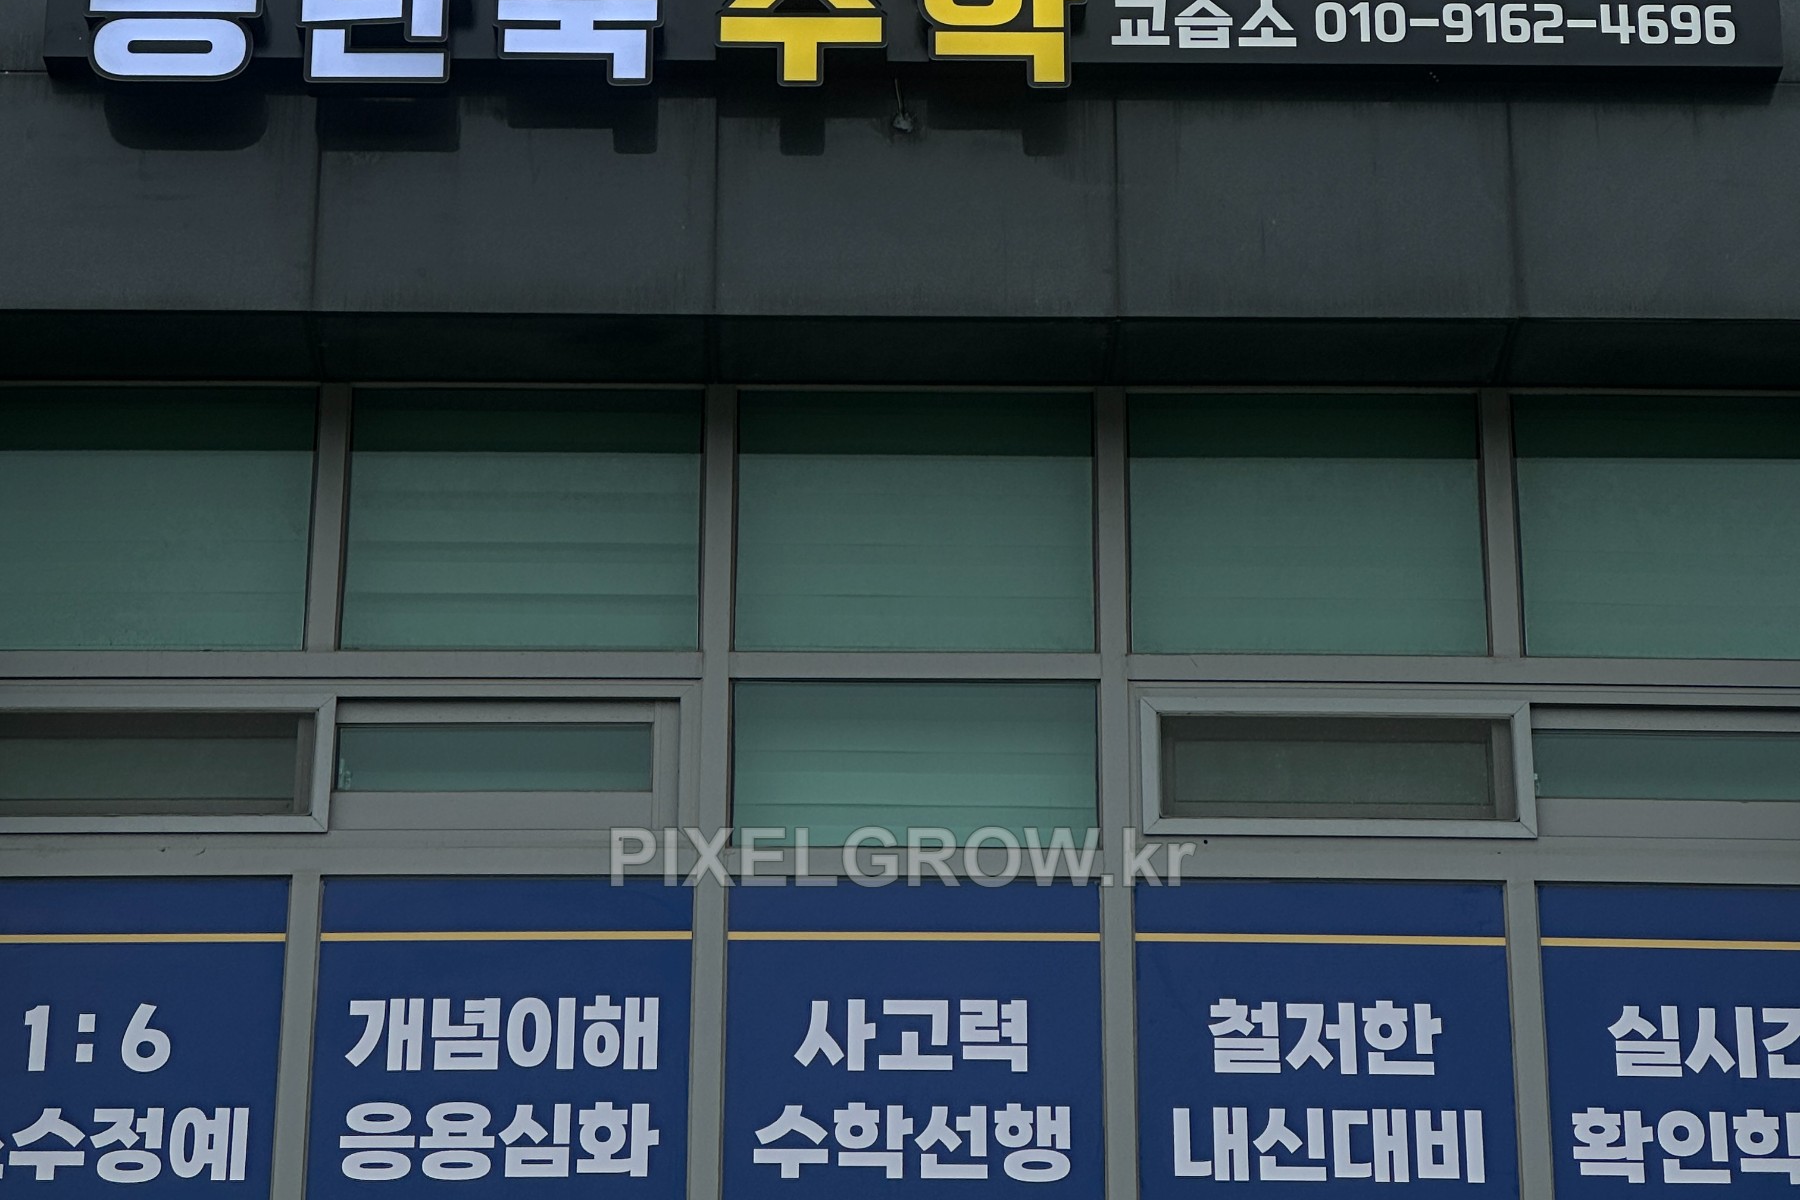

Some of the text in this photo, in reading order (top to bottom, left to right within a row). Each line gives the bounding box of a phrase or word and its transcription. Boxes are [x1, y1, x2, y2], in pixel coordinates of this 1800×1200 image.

[1315, 1, 1737, 45] 010-9162-4696
[344, 995, 660, 1071] 개념이해
[794, 999, 1028, 1072] 사고력
[1208, 999, 1442, 1076] 철저한
[0, 1107, 250, 1184] 수정예
[339, 1101, 660, 1181] 응용심화
[753, 1102, 1071, 1183] 수학선행
[1172, 1107, 1486, 1184] 내신대비
